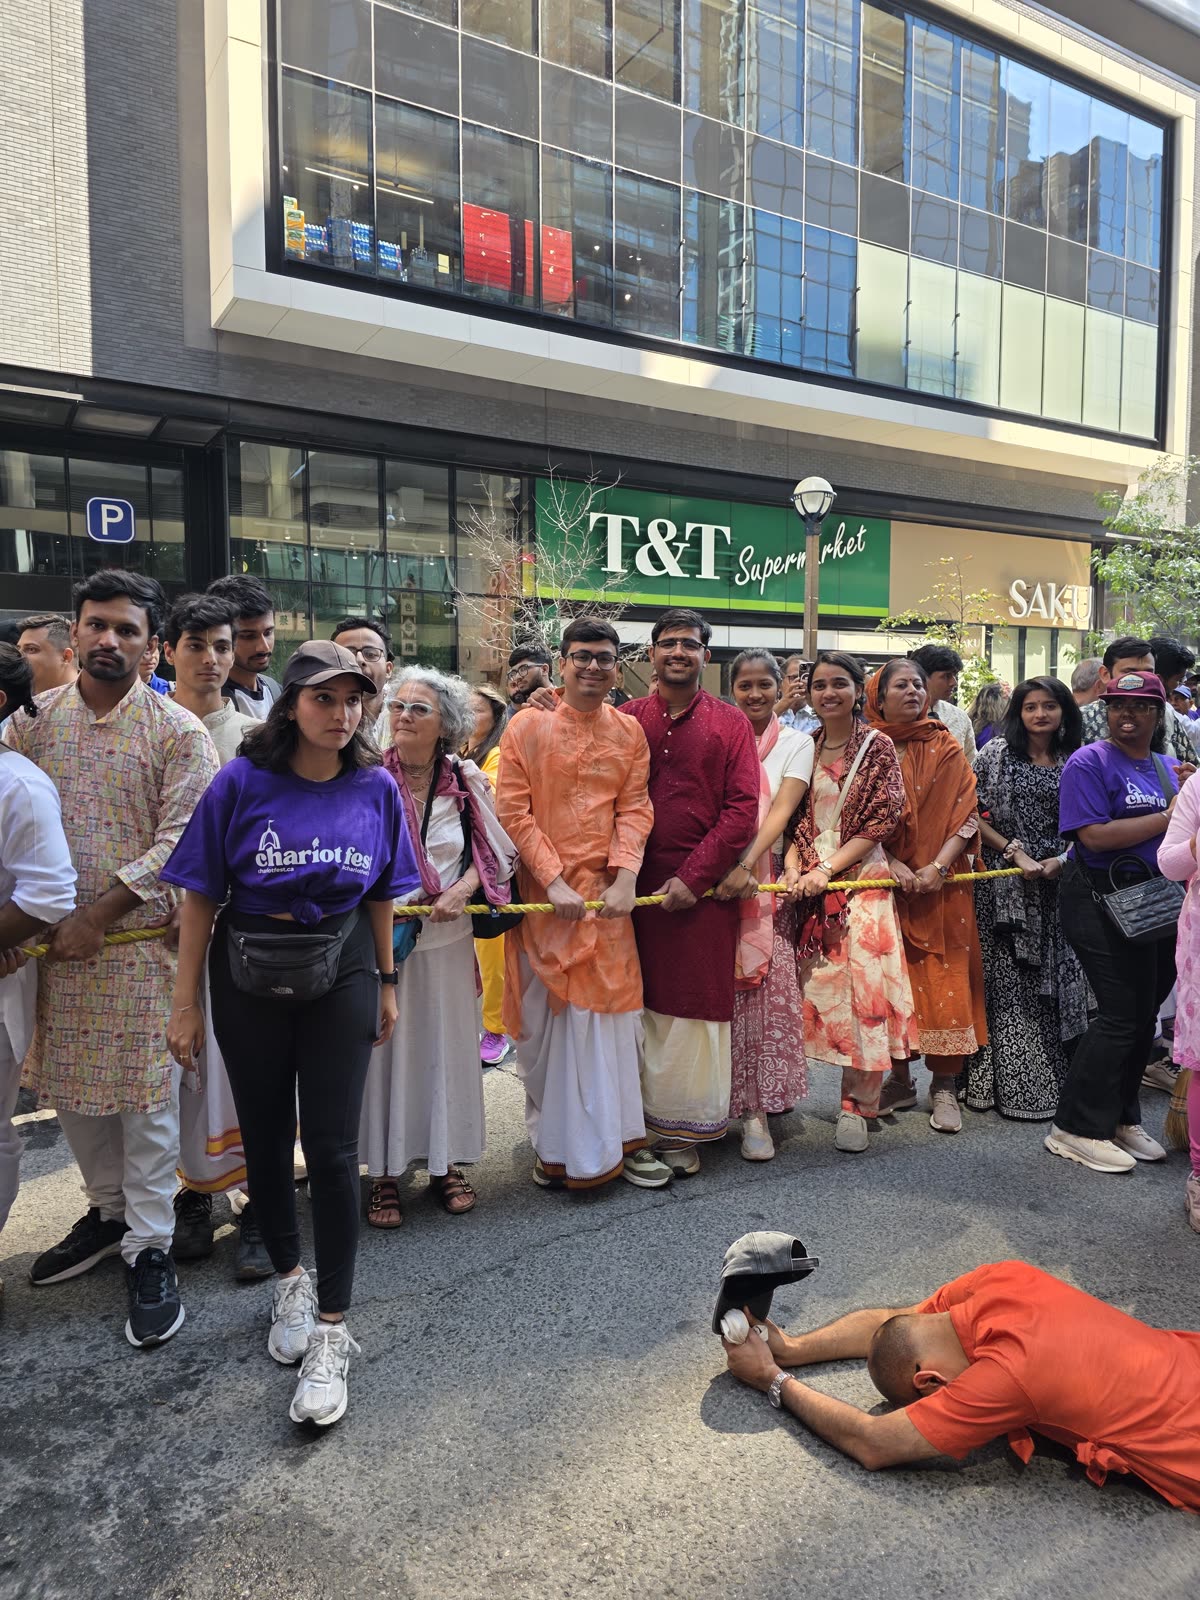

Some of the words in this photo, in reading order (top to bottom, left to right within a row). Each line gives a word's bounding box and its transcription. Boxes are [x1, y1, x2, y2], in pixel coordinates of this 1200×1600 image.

[101, 504, 124, 535] P
[589, 512, 731, 580] T&T
[734, 522, 866, 595] Supermrket
[1008, 579, 1094, 622] SAKU
[1125, 792, 1167, 808] chario
[256, 839, 342, 867] chariot
